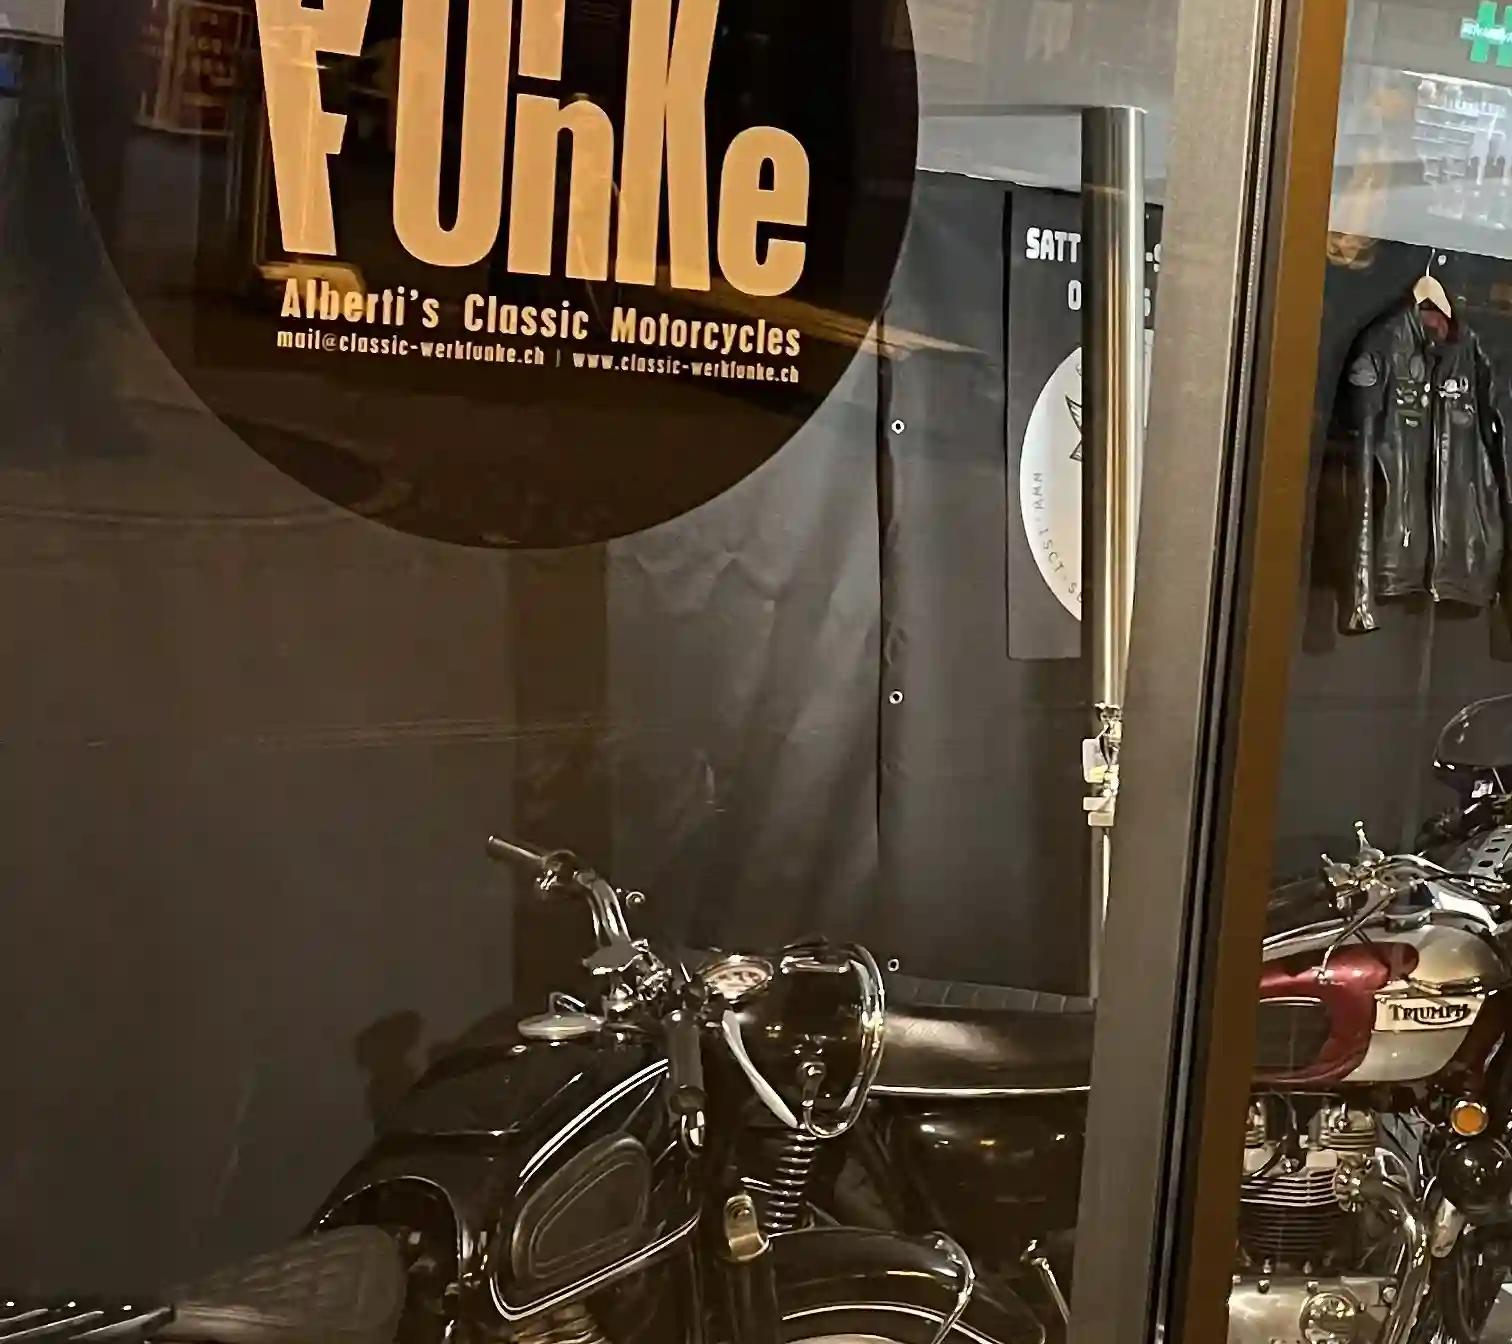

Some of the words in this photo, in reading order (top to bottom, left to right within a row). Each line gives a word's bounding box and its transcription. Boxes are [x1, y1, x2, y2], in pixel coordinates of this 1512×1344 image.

[280, 277, 440, 329] Alberti's
[464, 293, 589, 340] Classic
[610, 306, 801, 356] Motorcycles
[1389, 1004, 1472, 1025] TRIUMPH
